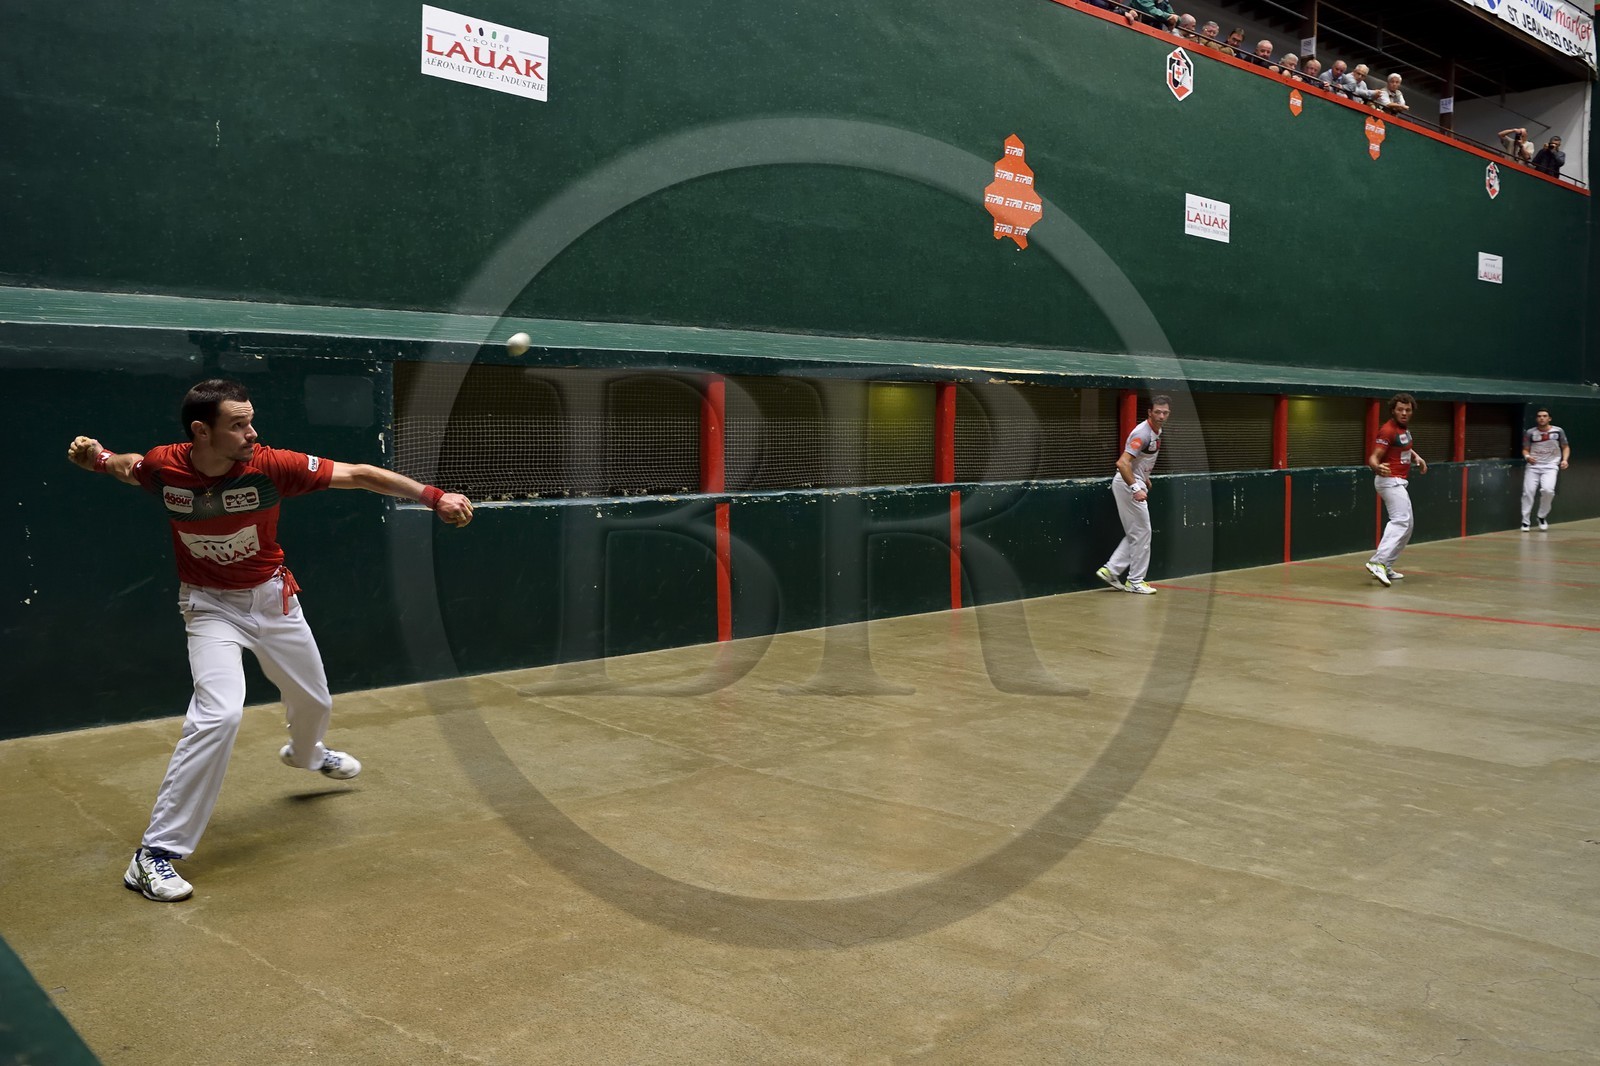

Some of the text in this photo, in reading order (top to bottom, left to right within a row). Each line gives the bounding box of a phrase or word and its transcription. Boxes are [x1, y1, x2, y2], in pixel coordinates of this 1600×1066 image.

[1507, 5, 1519, 24] ST
[463, 36, 511, 52] GROUPE
[426, 34, 544, 81] LAUAK
[500, 76, 545, 92] INDUSTRIE
[1187, 210, 1229, 231] LAUAK
